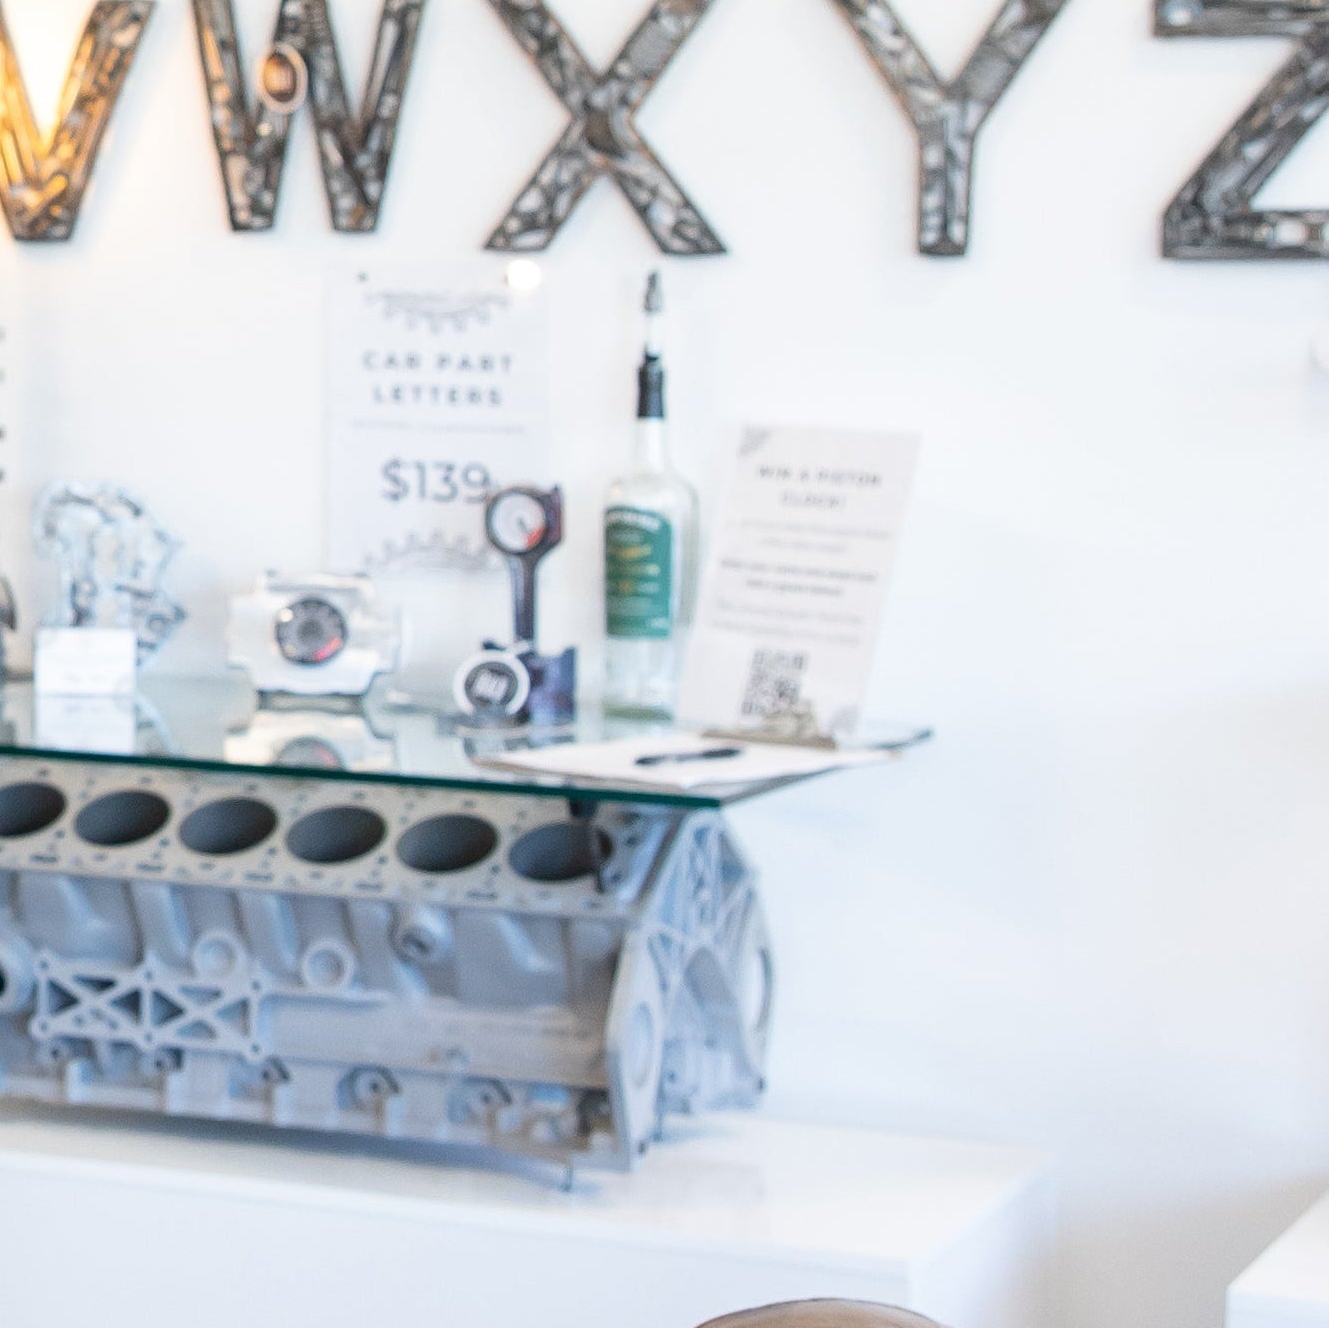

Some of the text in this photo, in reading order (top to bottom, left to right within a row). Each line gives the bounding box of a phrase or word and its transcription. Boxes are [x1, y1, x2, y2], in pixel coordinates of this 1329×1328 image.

[361, 350, 513, 372] CAR PART
[372, 383, 503, 407] LETTERS
[381, 455, 491, 503] $139
